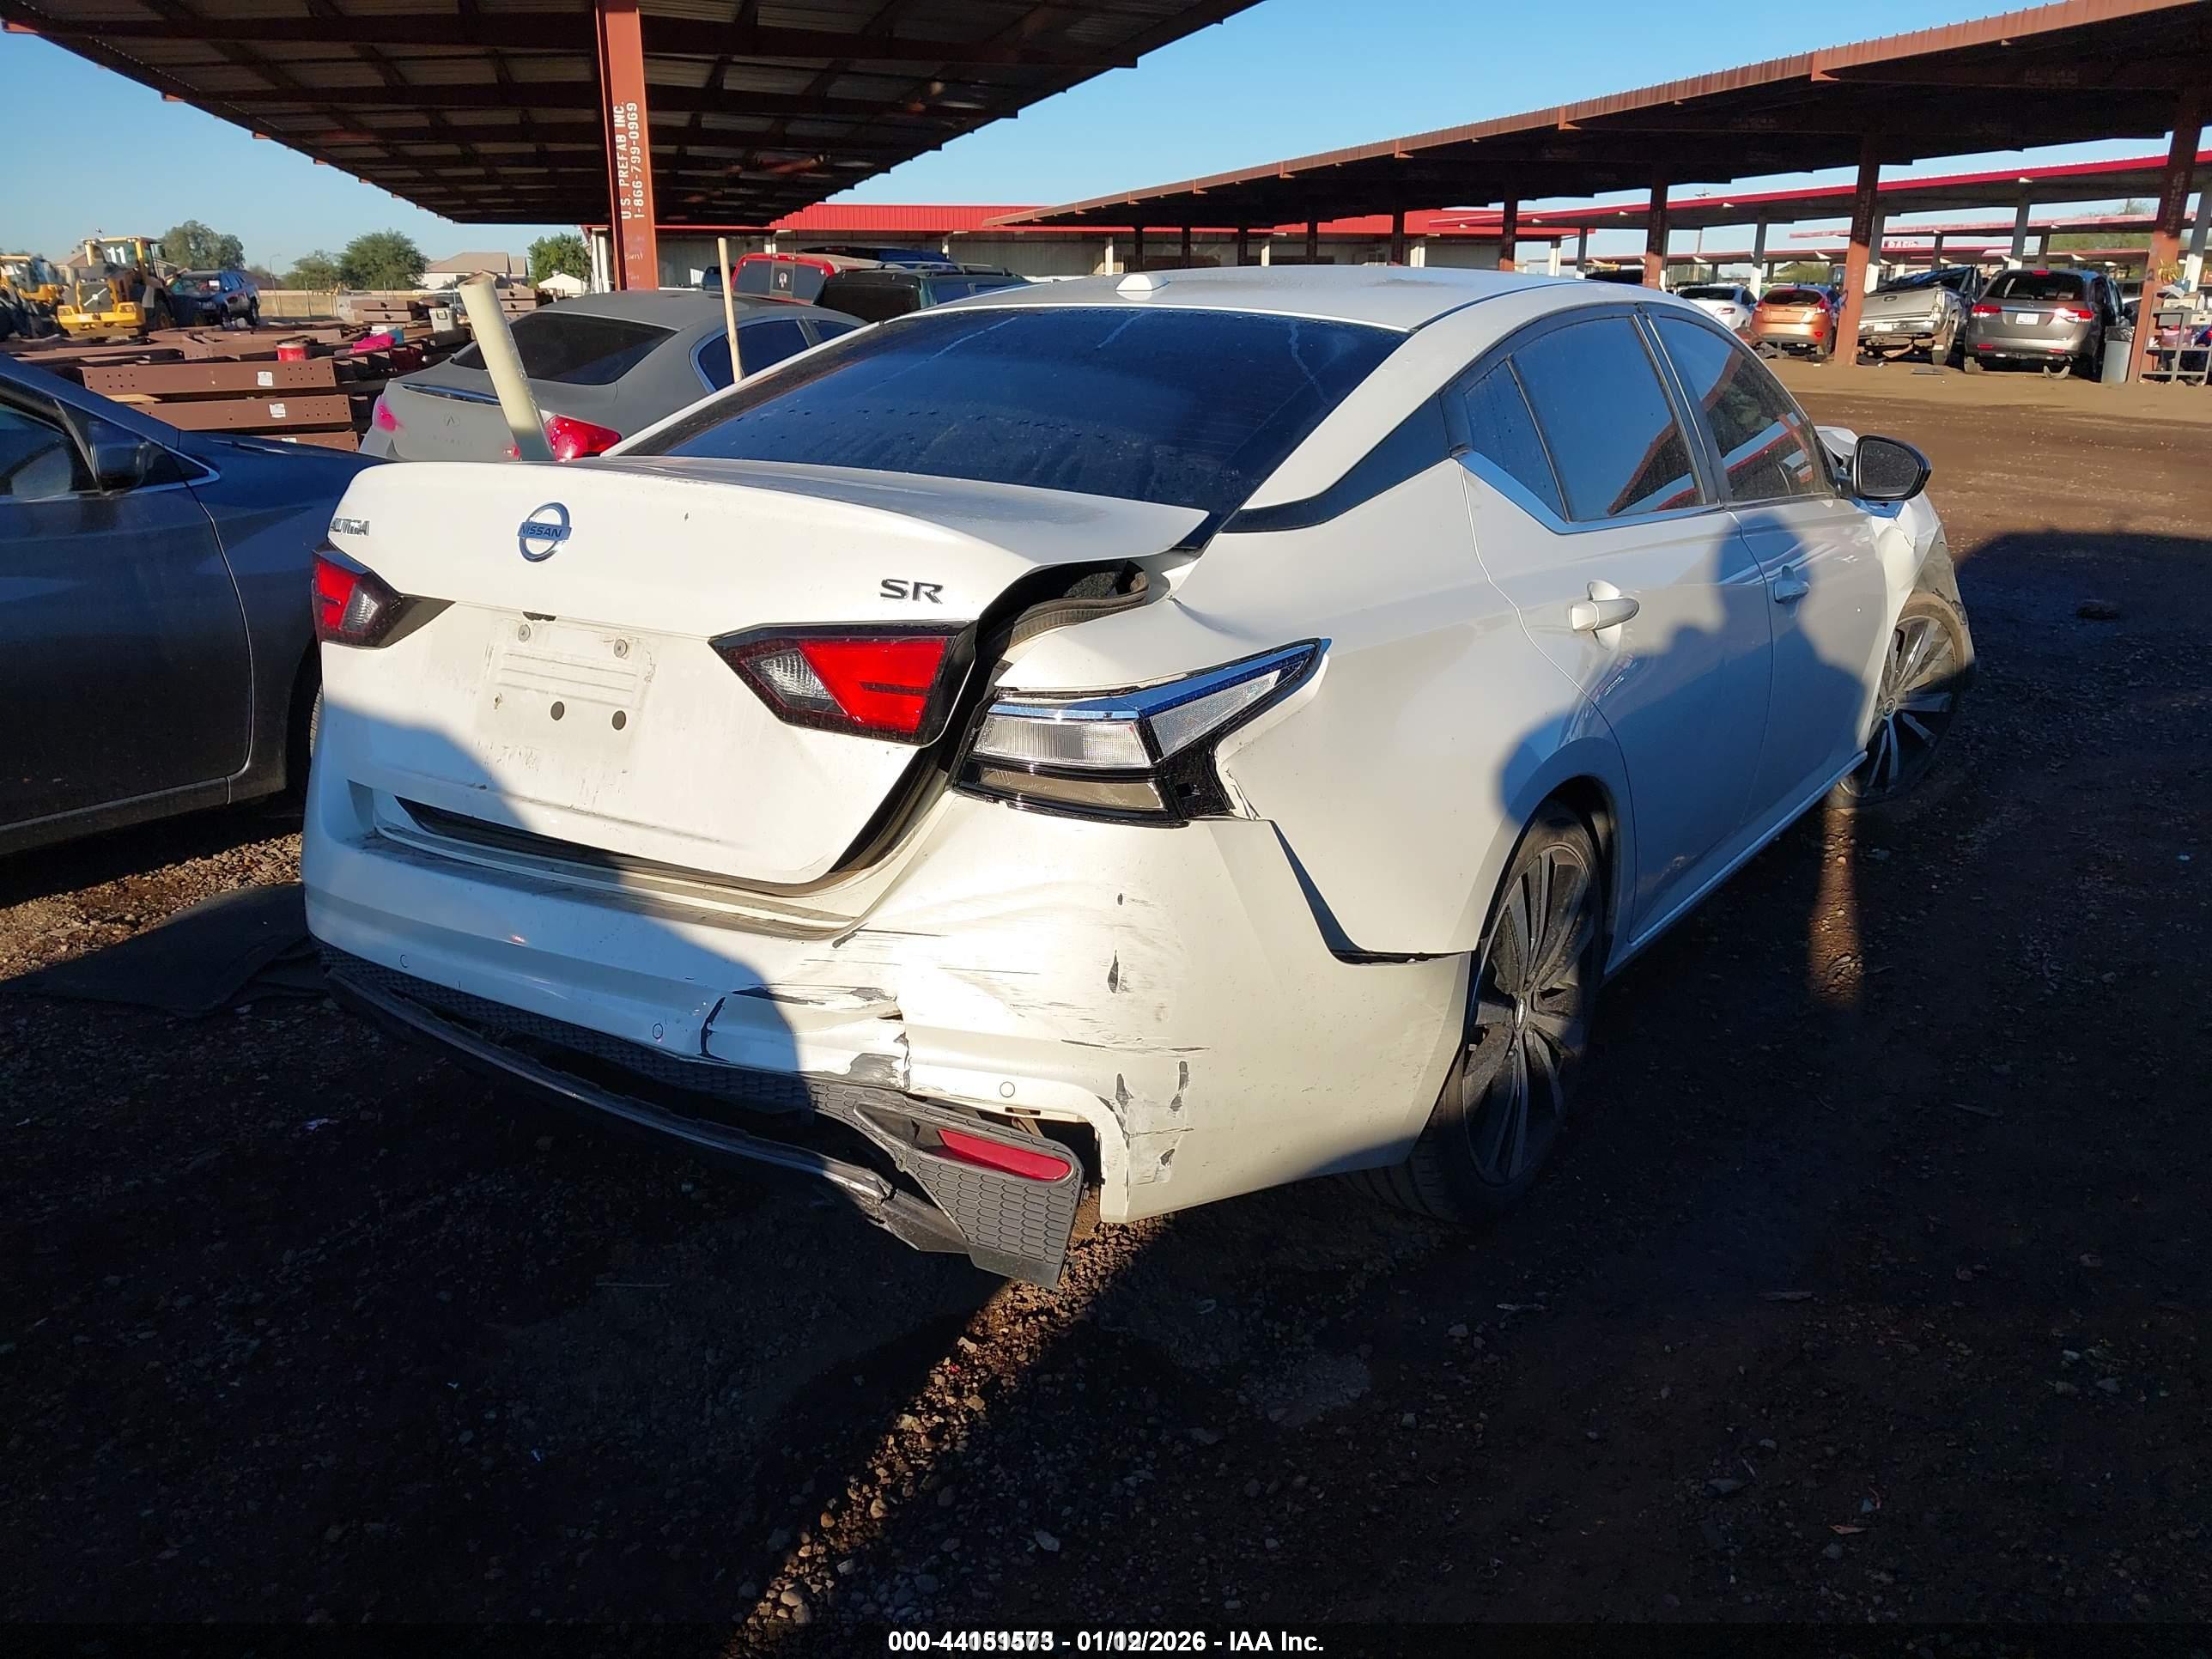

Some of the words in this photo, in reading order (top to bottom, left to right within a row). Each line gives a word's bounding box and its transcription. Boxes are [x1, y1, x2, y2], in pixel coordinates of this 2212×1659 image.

[613, 101, 626, 128] INC.
[616, 133, 630, 187] PREFAB
[626, 102, 646, 219] 1-866-799-0969
[621, 193, 632, 220] U.S.
[106, 246, 126, 264] 11
[520, 525, 562, 538] NISSAN
[879, 578, 944, 605] SR
